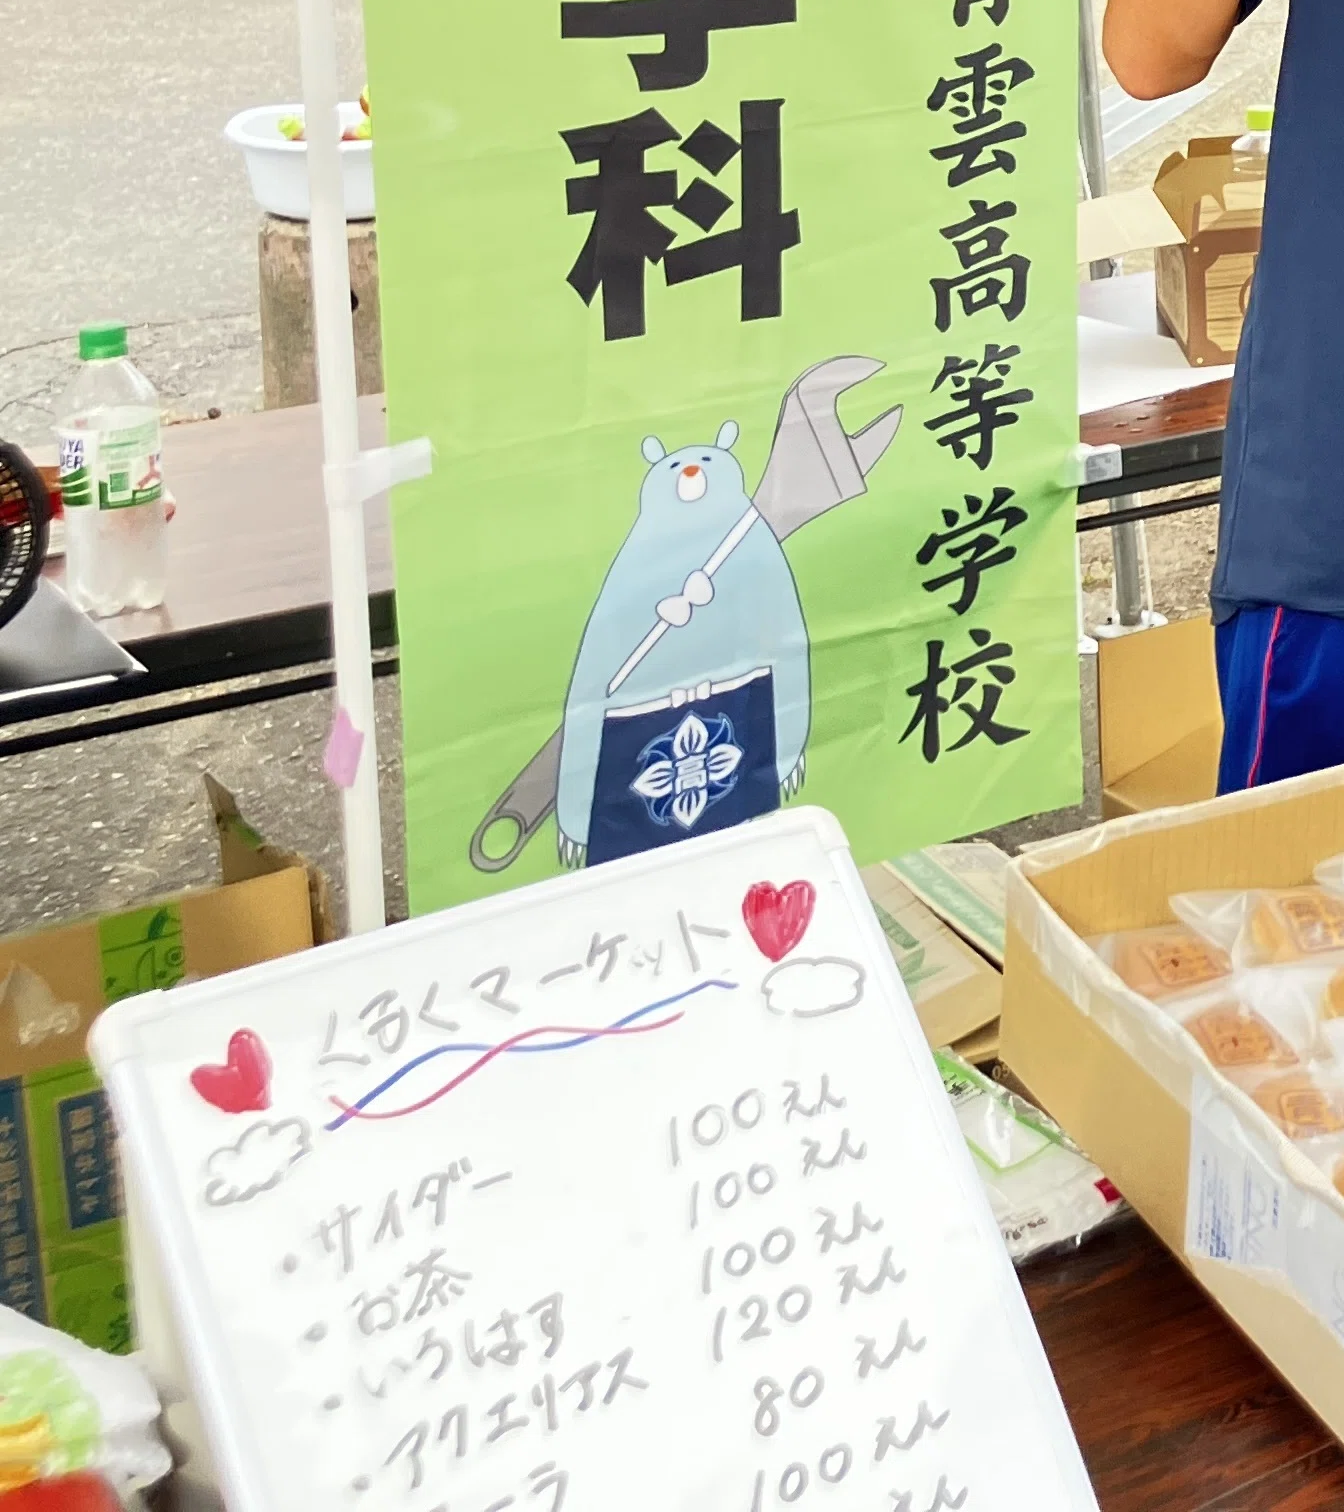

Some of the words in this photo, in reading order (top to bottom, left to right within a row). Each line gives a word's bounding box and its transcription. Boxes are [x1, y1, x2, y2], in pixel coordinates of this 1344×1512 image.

[312, 1155, 514, 1274] サイダー
[349, 1247, 474, 1336] お茶
[358, 1290, 566, 1400] いろはす
[383, 1346, 652, 1490] アクエリアス
